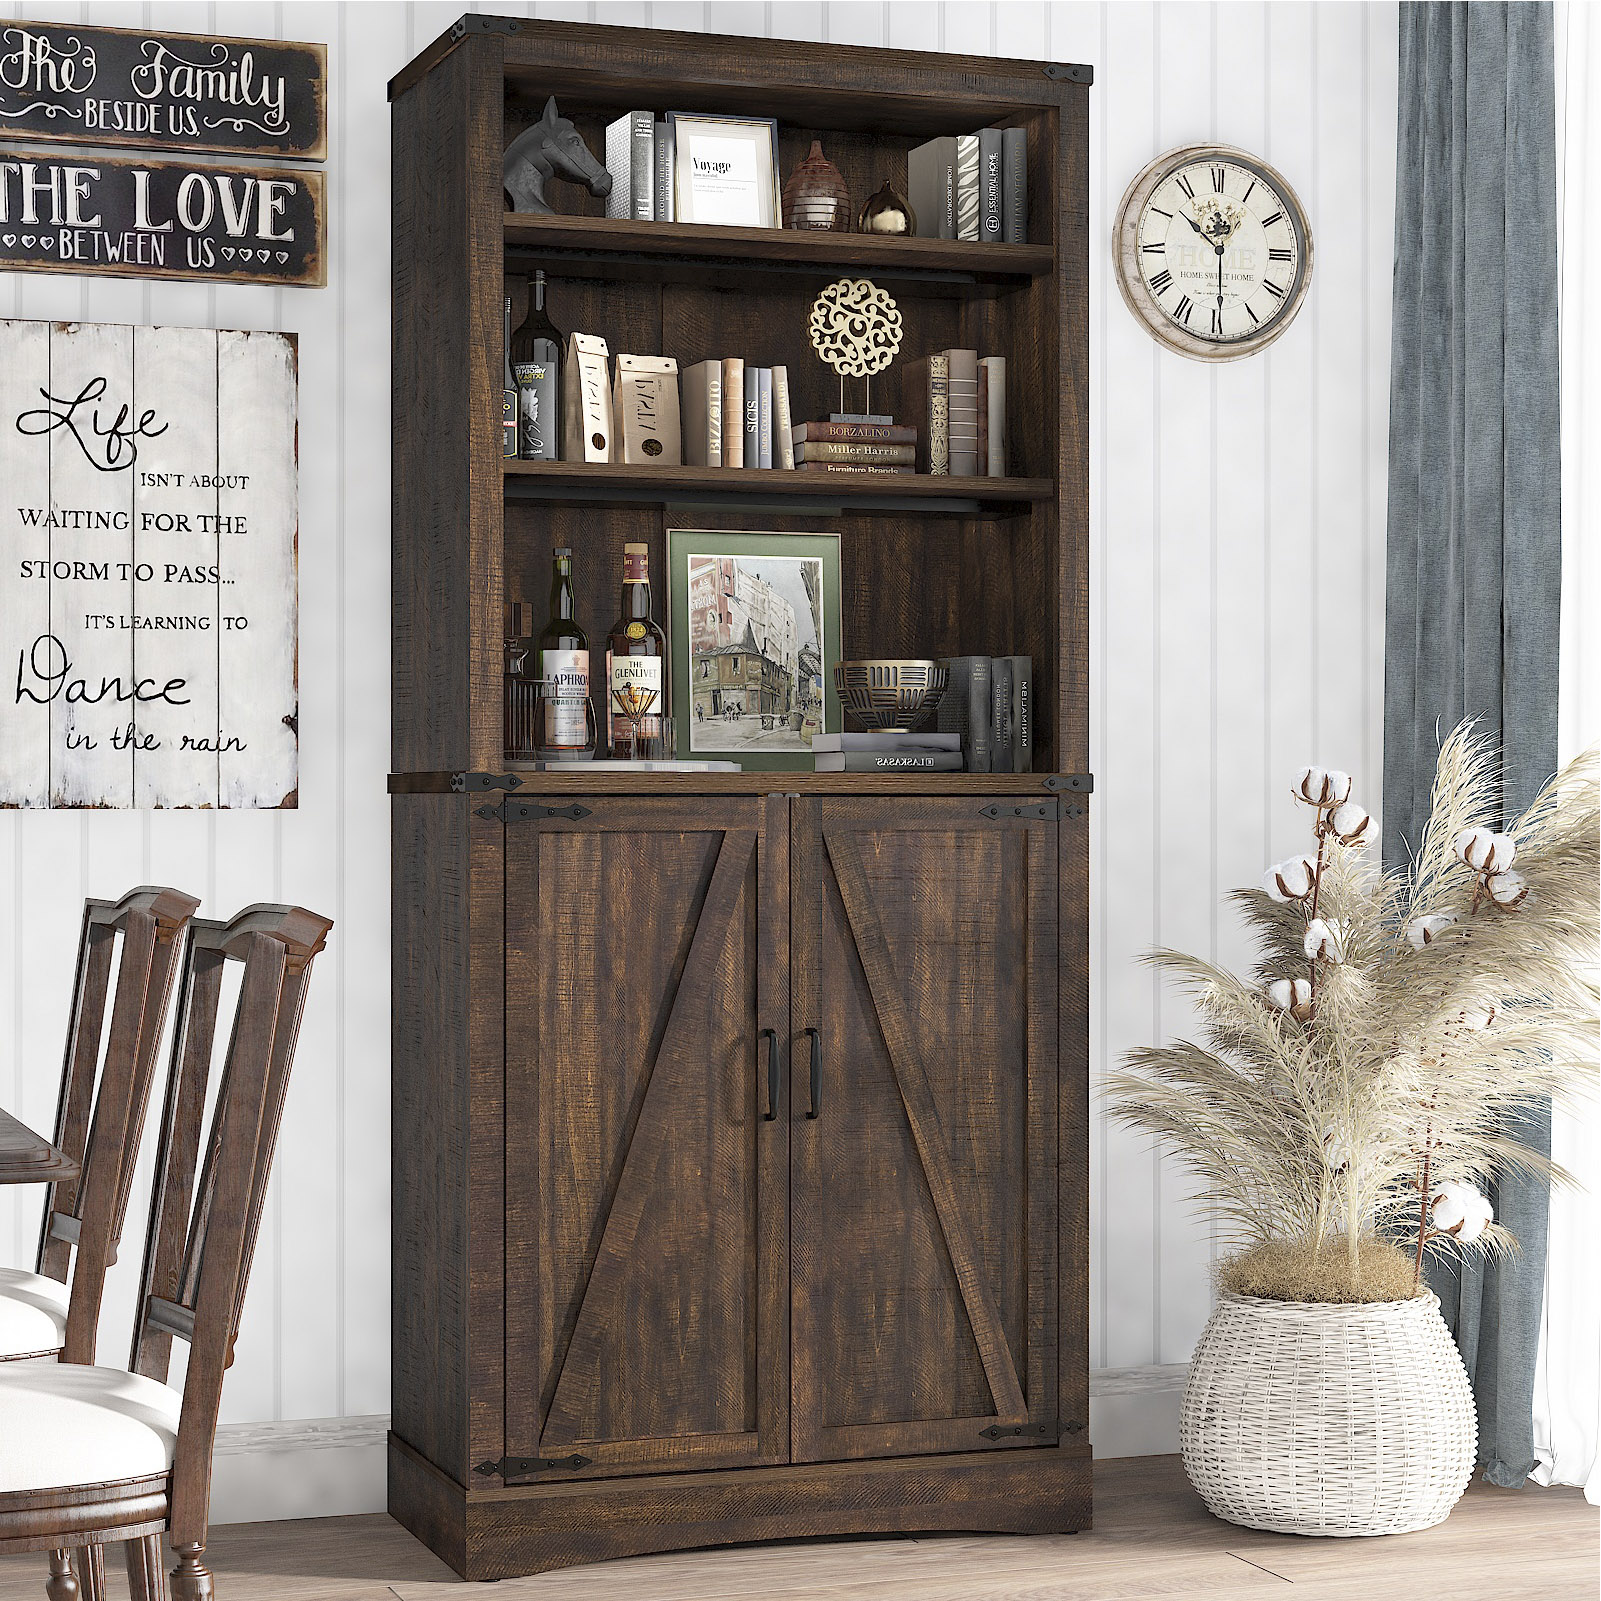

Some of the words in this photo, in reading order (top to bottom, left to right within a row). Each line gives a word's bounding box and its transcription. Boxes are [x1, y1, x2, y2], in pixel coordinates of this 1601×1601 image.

[0, 28, 96, 93] The
[130, 40, 285, 126] Family
[85, 98, 162, 134] BESIDE
[169, 105, 201, 138] US,
[693, 157, 731, 174] Voyage
[988, 152, 998, 175] HOME
[0, 162, 102, 227] THE
[131, 171, 297, 242] LOVE
[988, 176, 997, 214] ESSENTIAL
[59, 229, 164, 265] BETWEEN
[186, 237, 216, 268] US
[1180, 271, 1204, 279] HOME
[746, 400, 759, 433] SICIS
[760, 390, 769, 432] COLLECTION
[777, 381, 789, 431] TRUSSARDI
[16, 377, 169, 471] Life
[829, 426, 891, 438] BORZALINO
[761, 432, 769, 456] JUMBO
[828, 445, 861, 454] Miller
[863, 445, 899, 456] Harris
[141, 472, 185, 488] ISN'T
[189, 475, 250, 489] ABOUT
[827, 464, 867, 473] Furniture
[867, 466, 899, 474] Brands
[18, 508, 130, 530] WAITING
[141, 513, 192, 533] FOR
[196, 514, 248, 535] THE
[20, 560, 109, 580] STORM
[117, 563, 154, 581] TO
[164, 564, 235, 585] PASS...
[84, 615, 115, 629] IT'S
[120, 616, 211, 630] LEARNING
[223, 617, 249, 631] TO
[15, 634, 191, 705] Dance
[615, 668, 658, 680] GLENLIVET
[66, 727, 98, 751] in
[110, 721, 161, 751] the
[180, 730, 247, 752] rain
